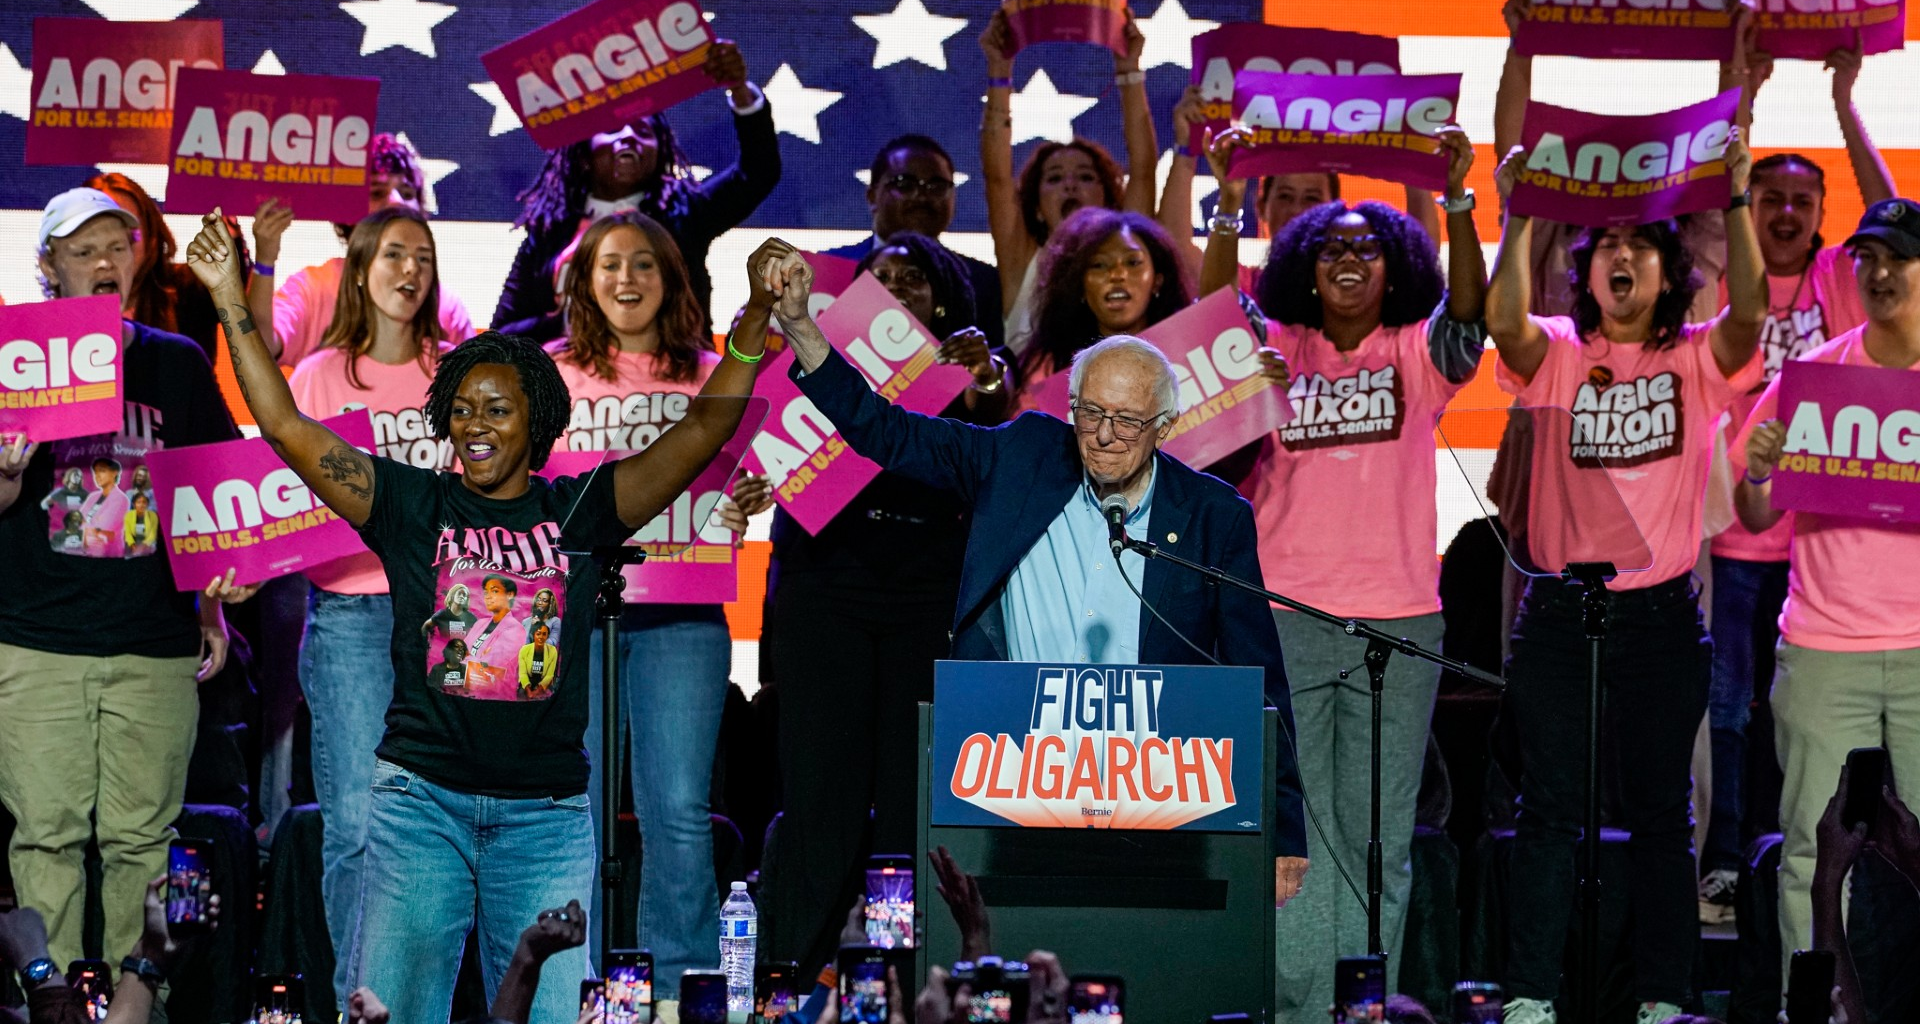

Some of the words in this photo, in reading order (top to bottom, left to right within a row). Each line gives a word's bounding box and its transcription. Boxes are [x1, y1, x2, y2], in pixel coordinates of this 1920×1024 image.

[1570, 8, 1609, 24] U.S.
[1613, 9, 1692, 27] SENATE
[36, 57, 218, 109] ANG
[34, 110, 72, 127] FOR
[76, 111, 113, 127] U.S.
[1277, 130, 1319, 144] U.S.
[1322, 132, 1404, 149] SENATE
[174, 157, 214, 177] FOR
[218, 163, 259, 181] U.S.
[263, 166, 332, 185] SENATE
[1566, 181, 1607, 198] U.S.
[1612, 170, 1687, 198] SENATE
[1307, 424, 1335, 440] U.S.
[1778, 455, 1822, 474] FOR
[1825, 458, 1868, 478] U.S.
[778, 465, 818, 503] FOR
[172, 535, 215, 554] FOR
[216, 530, 260, 550] U.S.
[432, 521, 569, 573] ANGIE
[449, 556, 476, 578] for
[1030, 668, 1163, 733] FIGHT
[950, 732, 1237, 804] OLIGARCHY
[1081, 806, 1113, 817] Bernie
